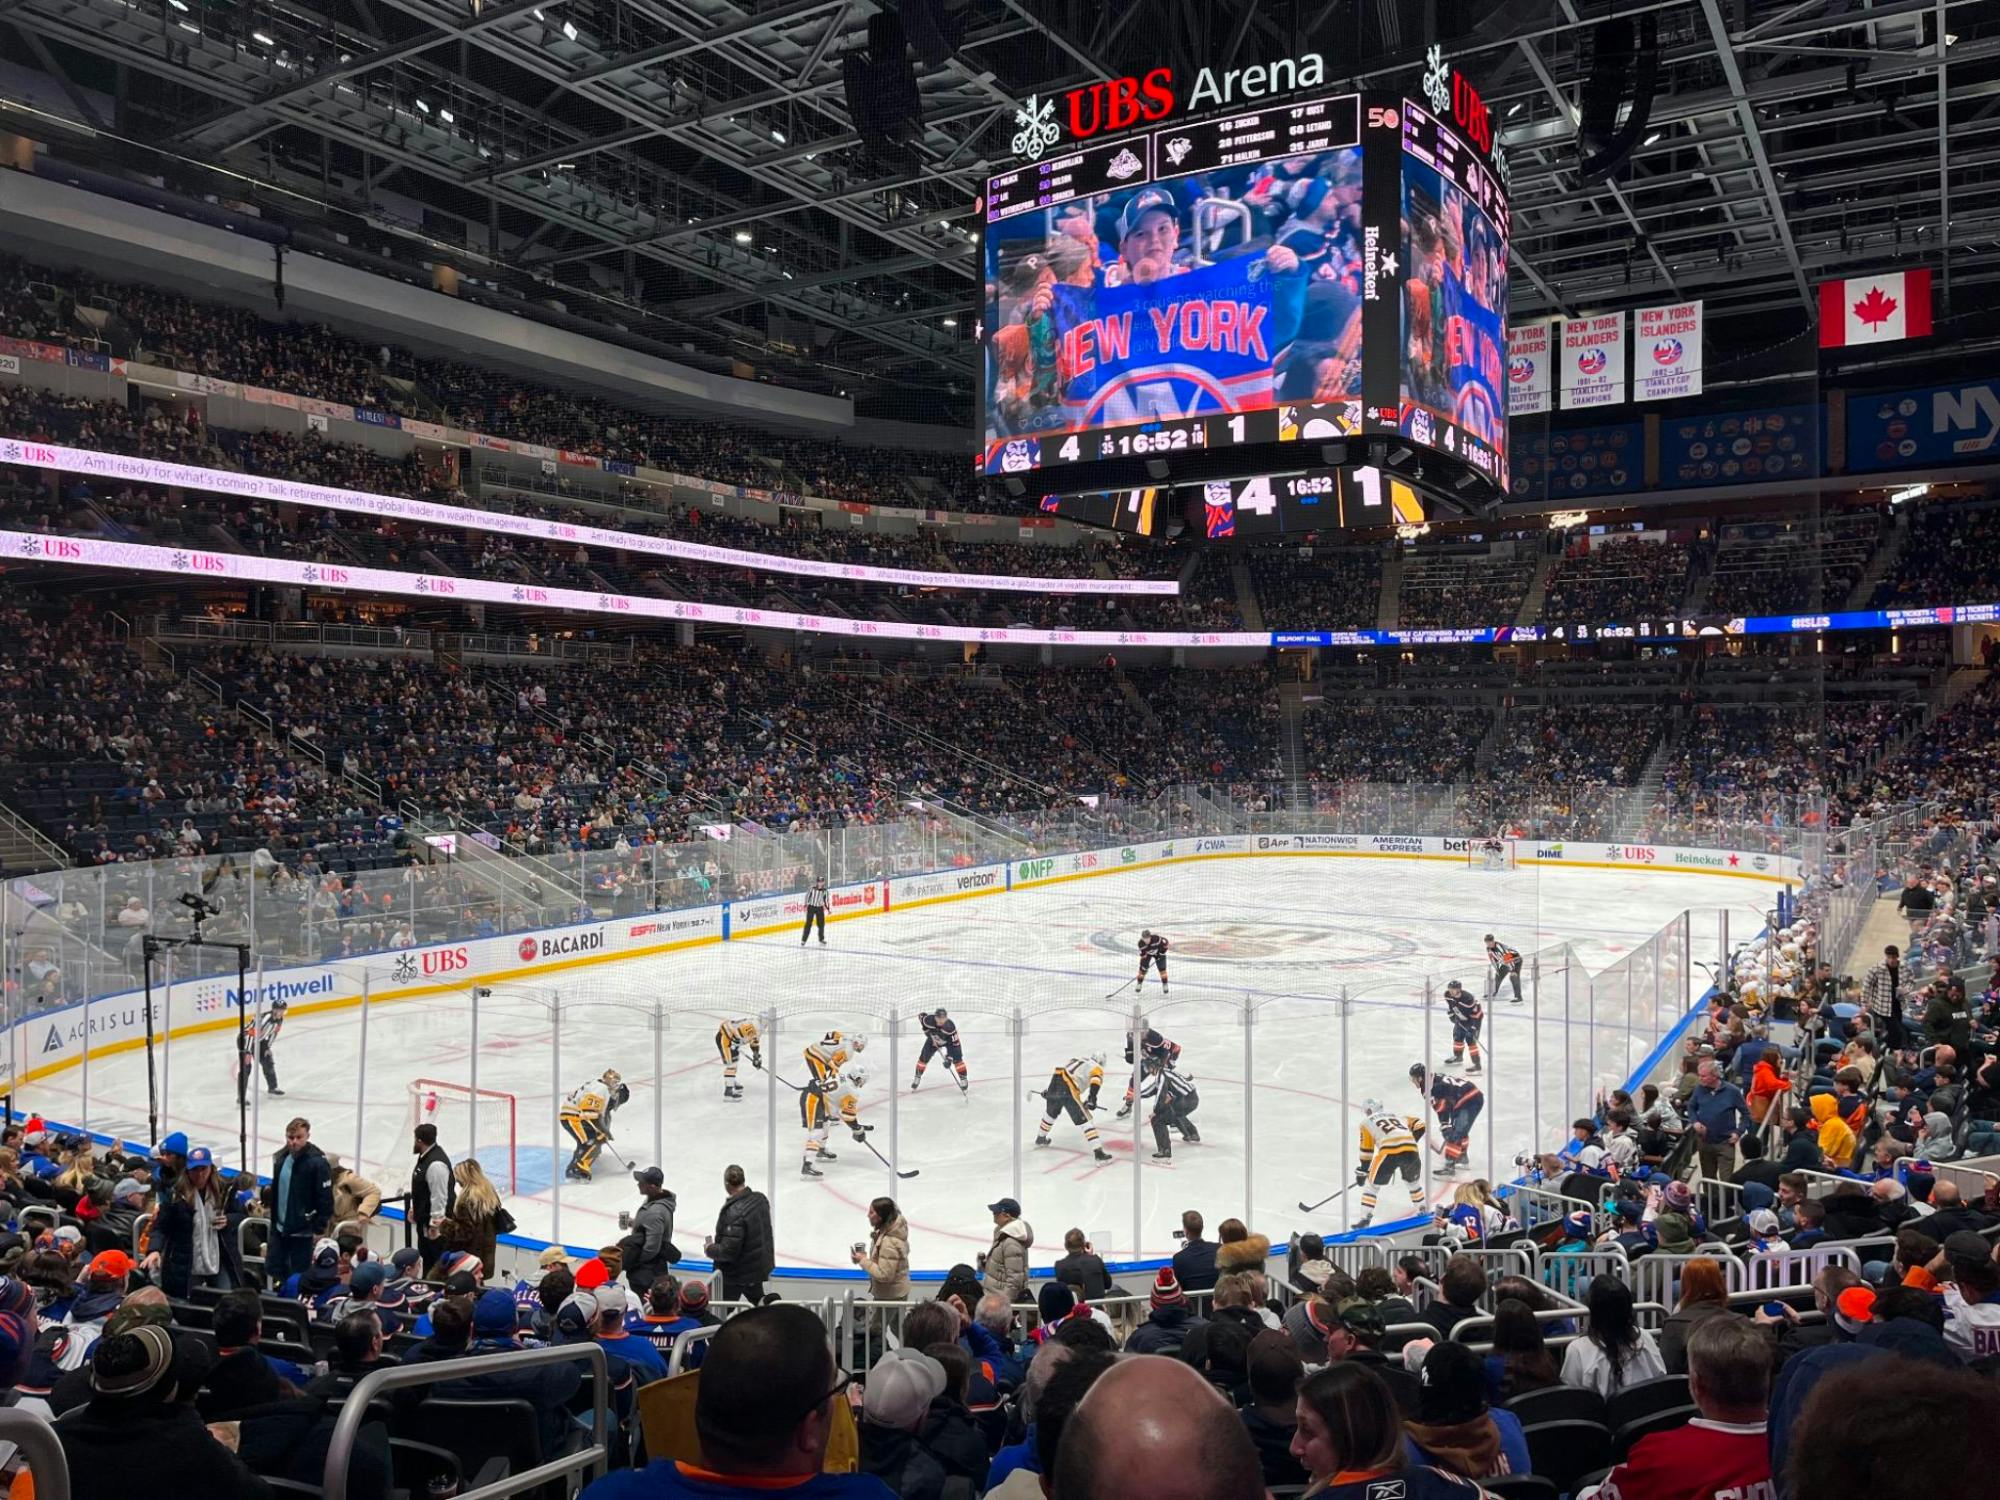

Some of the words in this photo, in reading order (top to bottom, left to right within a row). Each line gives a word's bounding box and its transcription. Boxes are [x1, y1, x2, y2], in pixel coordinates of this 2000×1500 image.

[1067, 67, 1174, 138] UBS
[1188, 52, 1324, 110] Arena
[1453, 70, 1489, 153] UBS
[1364, 225, 1380, 301] Heineken
[1642, 310, 1663, 323] NEW
[1669, 305, 1695, 319] YORK
[1149, 300, 1269, 362] YORK
[1521, 326, 1546, 339] YORK
[1567, 320, 1588, 333] NEW
[1592, 317, 1618, 330] YORK
[1640, 321, 1697, 338] ISLANDERS
[1566, 331, 1619, 348] ISLANDERS
[1647, 386, 1689, 397] CHAMPIONS
[1380, 407, 1397, 419] UBS
[1228, 415, 1246, 442] 1
[1119, 430, 1187, 454] 16:52
[1444, 425, 1454, 451] 4
[25, 446, 55, 463] UBS
[1059, 435, 1080, 461] 4
[83, 456, 107, 469] Am
[118, 461, 150, 479] ready
[154, 465, 171, 478] for
[175, 469, 213, 484] what's
[216, 475, 264, 493] coming?
[268, 482, 287, 496] Talk
[290, 487, 341, 502] retirement
[344, 493, 366, 507] with
[377, 498, 404, 513] global
[407, 502, 434, 517] leader
[447, 509, 475, 522] wealth
[1287, 477, 1332, 496] 16:52
[1353, 465, 1382, 506] 1
[1237, 477, 1276, 515] 4
[558, 527, 576, 538] UBS
[44, 540, 81, 557] UBS
[192, 555, 225, 571] UBS
[320, 569, 348, 583] UBS
[431, 579, 454, 593] UBS
[526, 589, 548, 601] UBS
[610, 598, 630, 609] UBS
[685, 605, 703, 616] UBS
[745, 610, 761, 621] UBS
[860, 623, 877, 633] UBS
[1552, 626, 1564, 638] 4
[1596, 626, 1634, 639] 16:52
[1204, 840, 1226, 850] CWA
[1305, 836, 1358, 844] NATIONWIDE
[1373, 836, 1422, 845] AMERICAN
[1379, 844, 1423, 852] EXPRESS
[1081, 854, 1097, 868] UBS
[1537, 849, 1563, 858] DIME
[1625, 847, 1655, 861] UBS
[1675, 852, 1723, 866] Heineken
[1030, 859, 1053, 879] NFP
[957, 872, 995, 890] verizon
[630, 924, 656, 937] ESPN
[542, 926, 605, 957] BACARDÍ
[421, 947, 468, 976] UBS
[226, 974, 333, 1008] Northwell
[68, 1004, 161, 1042] ACRISURE
[1376, 1118, 1408, 1135] 28
